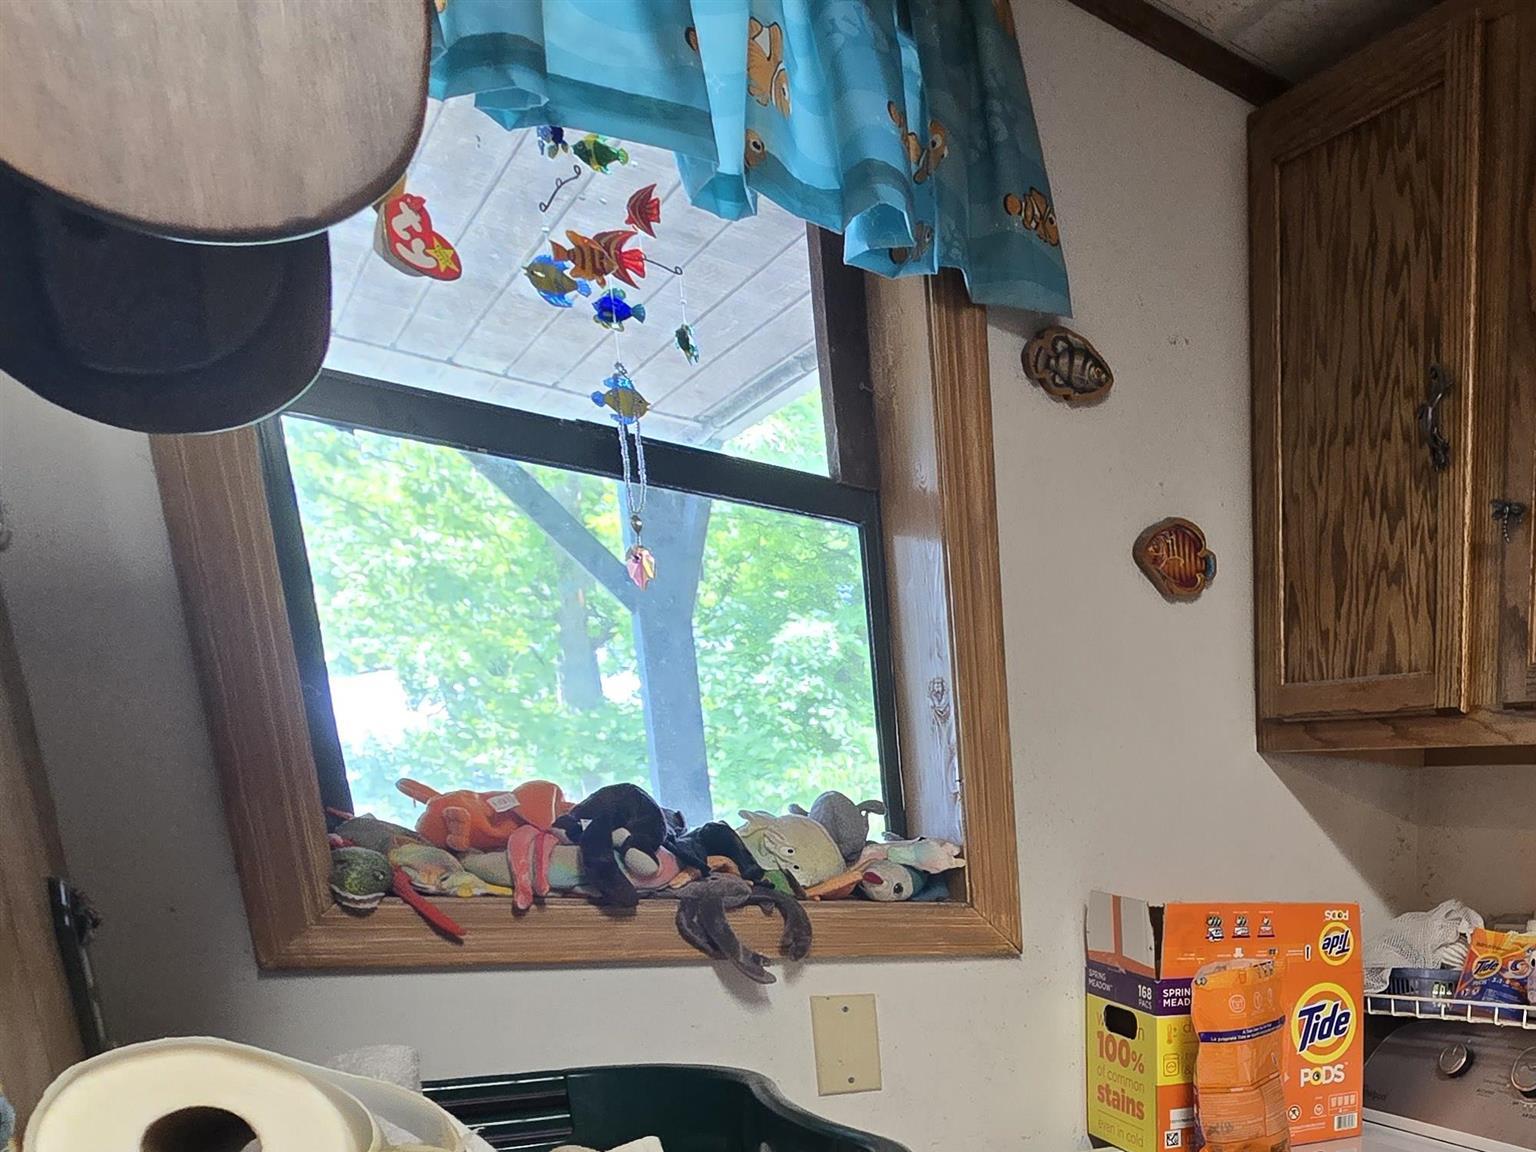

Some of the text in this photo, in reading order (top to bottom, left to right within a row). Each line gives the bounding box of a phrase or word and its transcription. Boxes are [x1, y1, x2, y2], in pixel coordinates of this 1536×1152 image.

[392, 201, 437, 269] ty
[1321, 929, 1351, 955] Tide
[1473, 959, 1500, 975] Tide
[1138, 984, 1152, 1000] 168
[1163, 988, 1191, 998] SPRIN
[1163, 997, 1191, 1007] MEAD
[1297, 999, 1353, 1053] Tide
[1097, 1033, 1145, 1074] 100%
[1107, 1069, 1145, 1093] common
[1300, 1064, 1346, 1087] PODS
[1097, 1083, 1145, 1121] stains
[1126, 1130, 1144, 1148] cold
